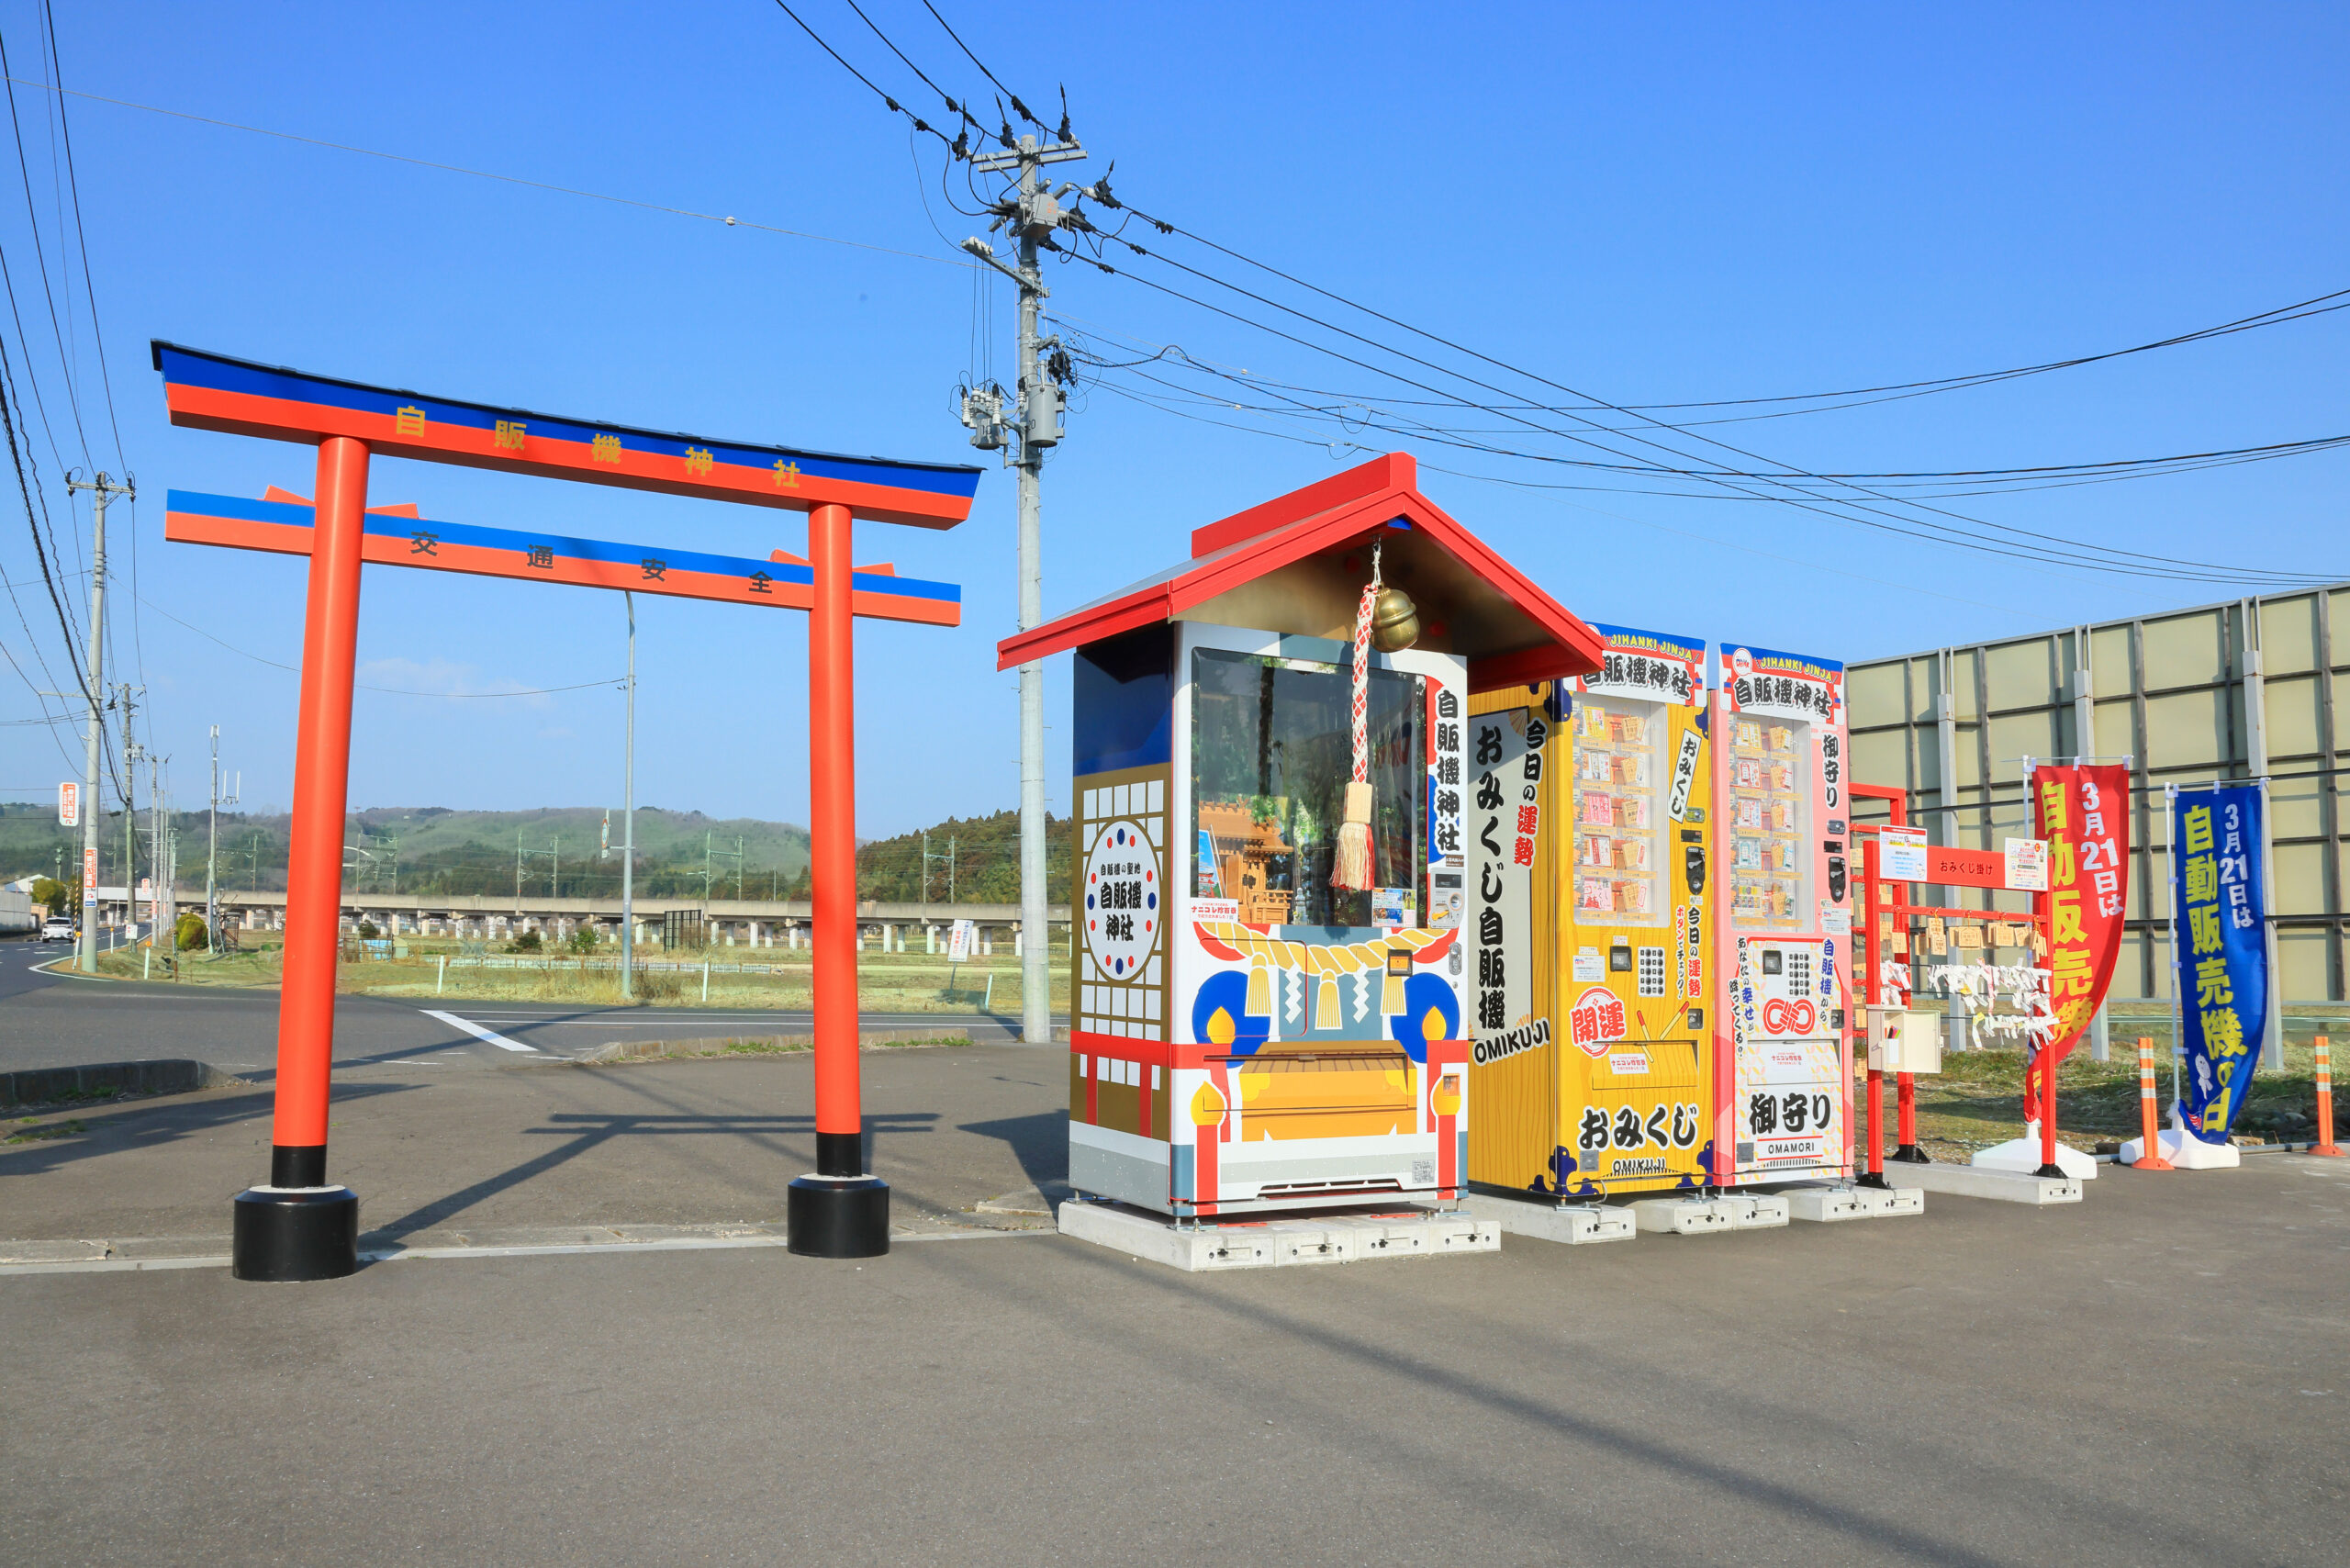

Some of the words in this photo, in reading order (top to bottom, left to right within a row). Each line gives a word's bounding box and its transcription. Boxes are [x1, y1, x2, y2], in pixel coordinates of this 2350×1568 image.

[396, 406, 800, 490] 自販機神社
[410, 531, 774, 594] 交通安全
[1611, 634, 1657, 648] JIHANKI
[1661, 642, 1692, 660] JINJA
[1761, 657, 1802, 670] JIHANKI
[1805, 664, 1831, 681] JINJA
[1734, 677, 1831, 716] 自販機神社
[1438, 689, 1460, 851] 自販機神社
[1515, 720, 1546, 867] 今日の運勢
[1672, 737, 1696, 815] おみくじ
[1823, 735, 1839, 808] 御守り
[1476, 725, 1505, 1030] おみくじ自販機
[1940, 860, 1993, 875] おみくじ掛け
[2080, 782, 2123, 918] 3月21日は
[2220, 804, 2254, 929] 3月21日は
[1101, 880, 1142, 910] 自販機
[1106, 913, 1134, 941] 神社
[1687, 907, 1701, 997] 今日の運勢
[1738, 937, 1754, 1031] あなたの幸せが
[1820, 939, 1834, 1022] 自販機から
[2184, 805, 2247, 1133] 自動販売機の日
[1474, 1021, 1550, 1061] OMIKUJI
[1571, 1001, 1625, 1045] 開運
[1580, 1105, 1696, 1149] おみくじ
[1750, 1092, 1830, 1135] 御守り
[1768, 1142, 1814, 1154] OMAMORI
